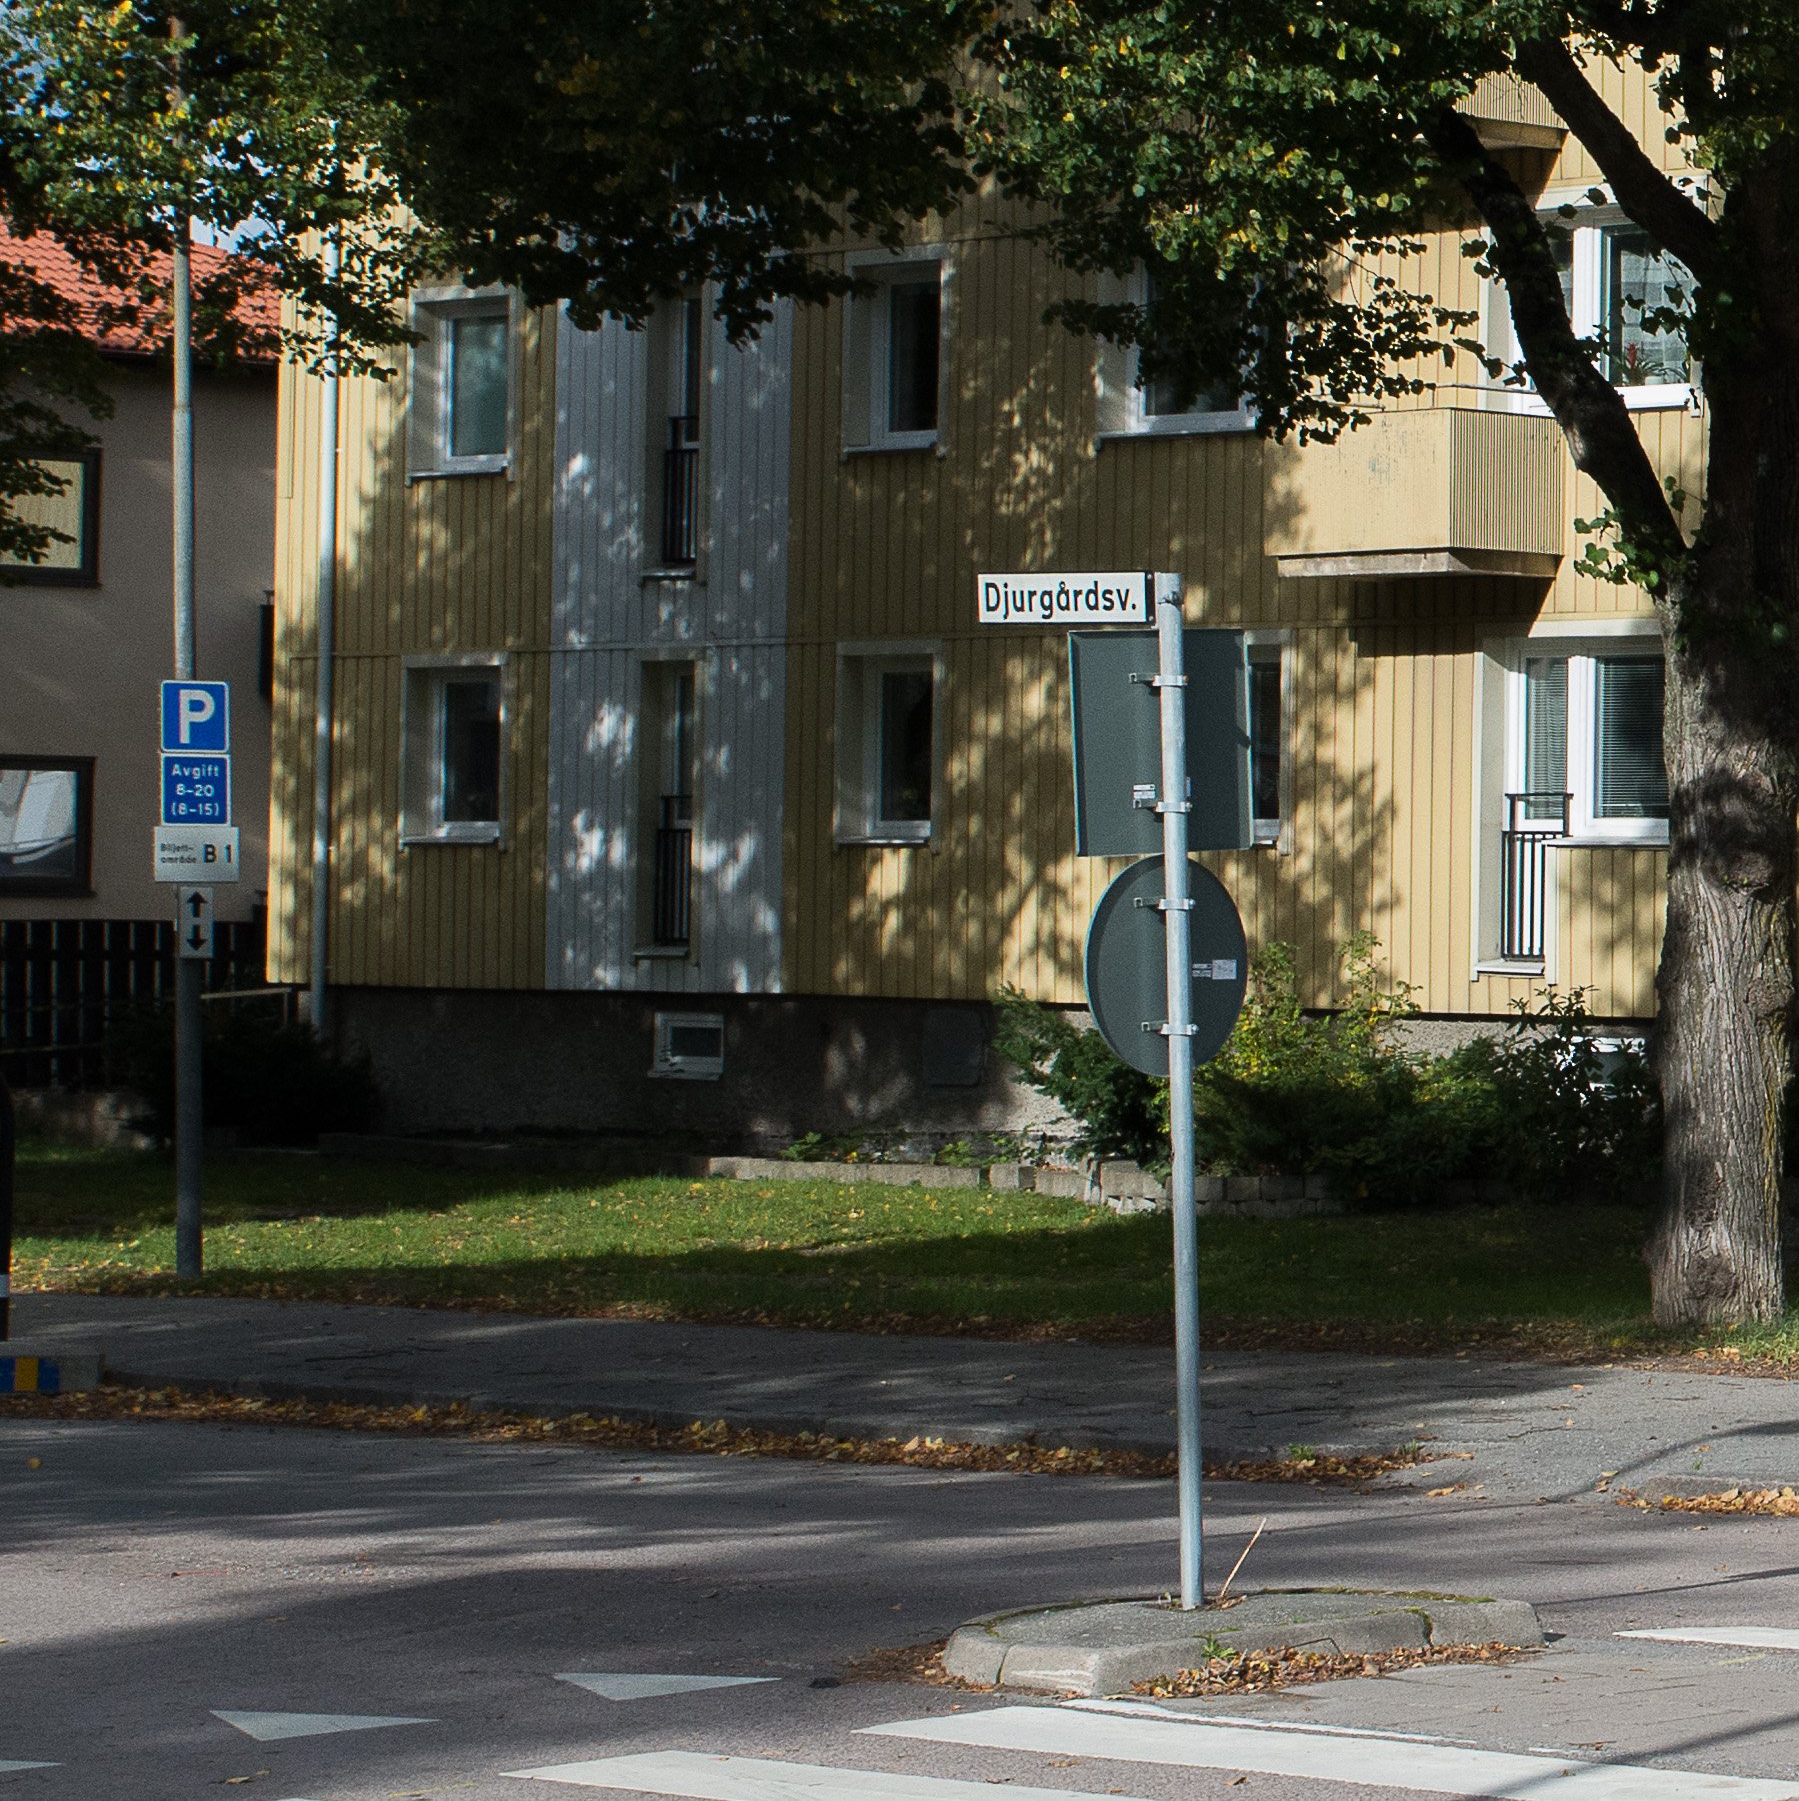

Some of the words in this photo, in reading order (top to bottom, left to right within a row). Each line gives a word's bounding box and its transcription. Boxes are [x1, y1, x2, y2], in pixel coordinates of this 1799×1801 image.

[984, 580, 1137, 620] Djurgårdsv.
[179, 689, 216, 744] P
[171, 764, 219, 779] Avgift
[171, 803, 220, 816] (8-15)
[203, 844, 217, 863] B
[224, 844, 232, 863] 1
